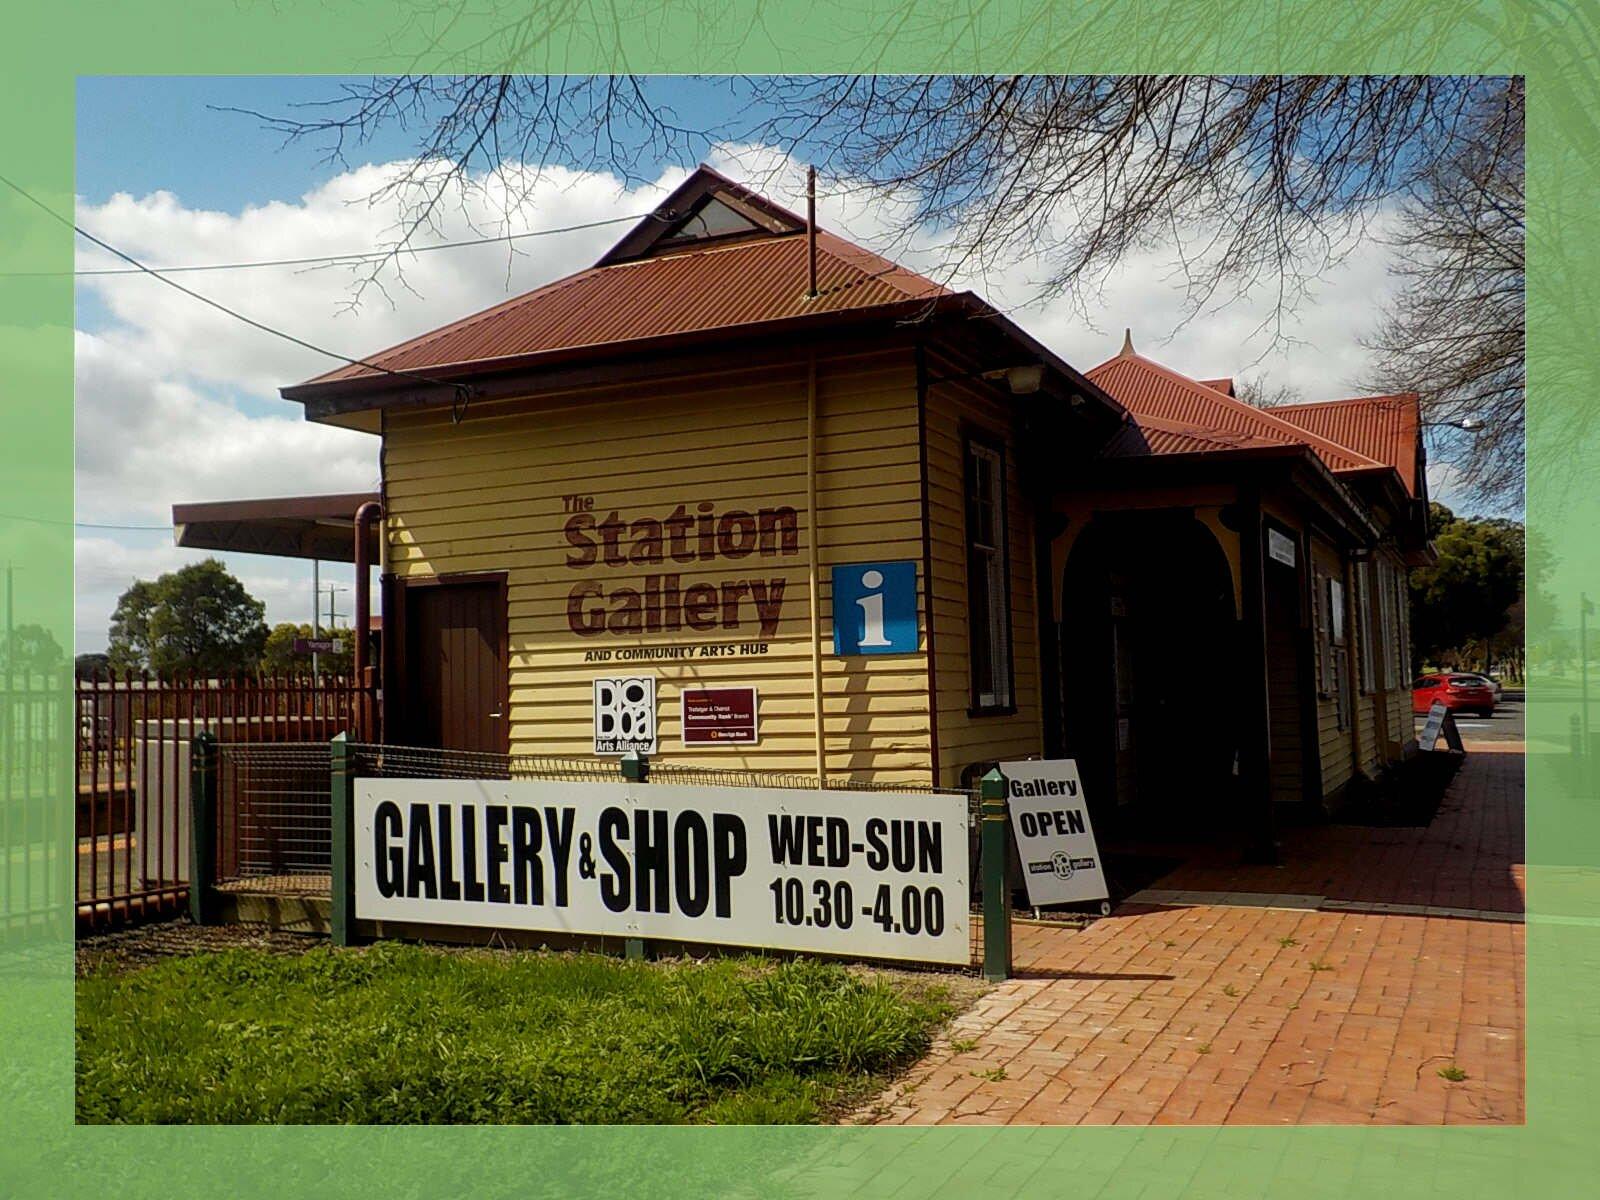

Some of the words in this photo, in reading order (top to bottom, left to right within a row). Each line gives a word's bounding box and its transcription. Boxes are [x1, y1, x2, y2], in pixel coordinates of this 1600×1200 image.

[561, 495, 595, 512] The
[563, 502, 799, 570] Station
[566, 574, 787, 640] Gallery
[584, 649, 612, 662] AND
[615, 645, 698, 661] COMMUNITY
[699, 644, 736, 657] ARTS
[742, 643, 769, 655] HUB
[596, 740, 615, 752] Arts
[616, 740, 650, 752] Alliance
[1010, 778, 1078, 797] Gallery
[767, 813, 943, 874] WED-SUN
[1019, 809, 1086, 838] OPEN
[374, 800, 576, 908] GALLERY
[578, 831, 597, 880] &
[598, 806, 748, 919] SHOP
[769, 876, 854, 930] 10.30
